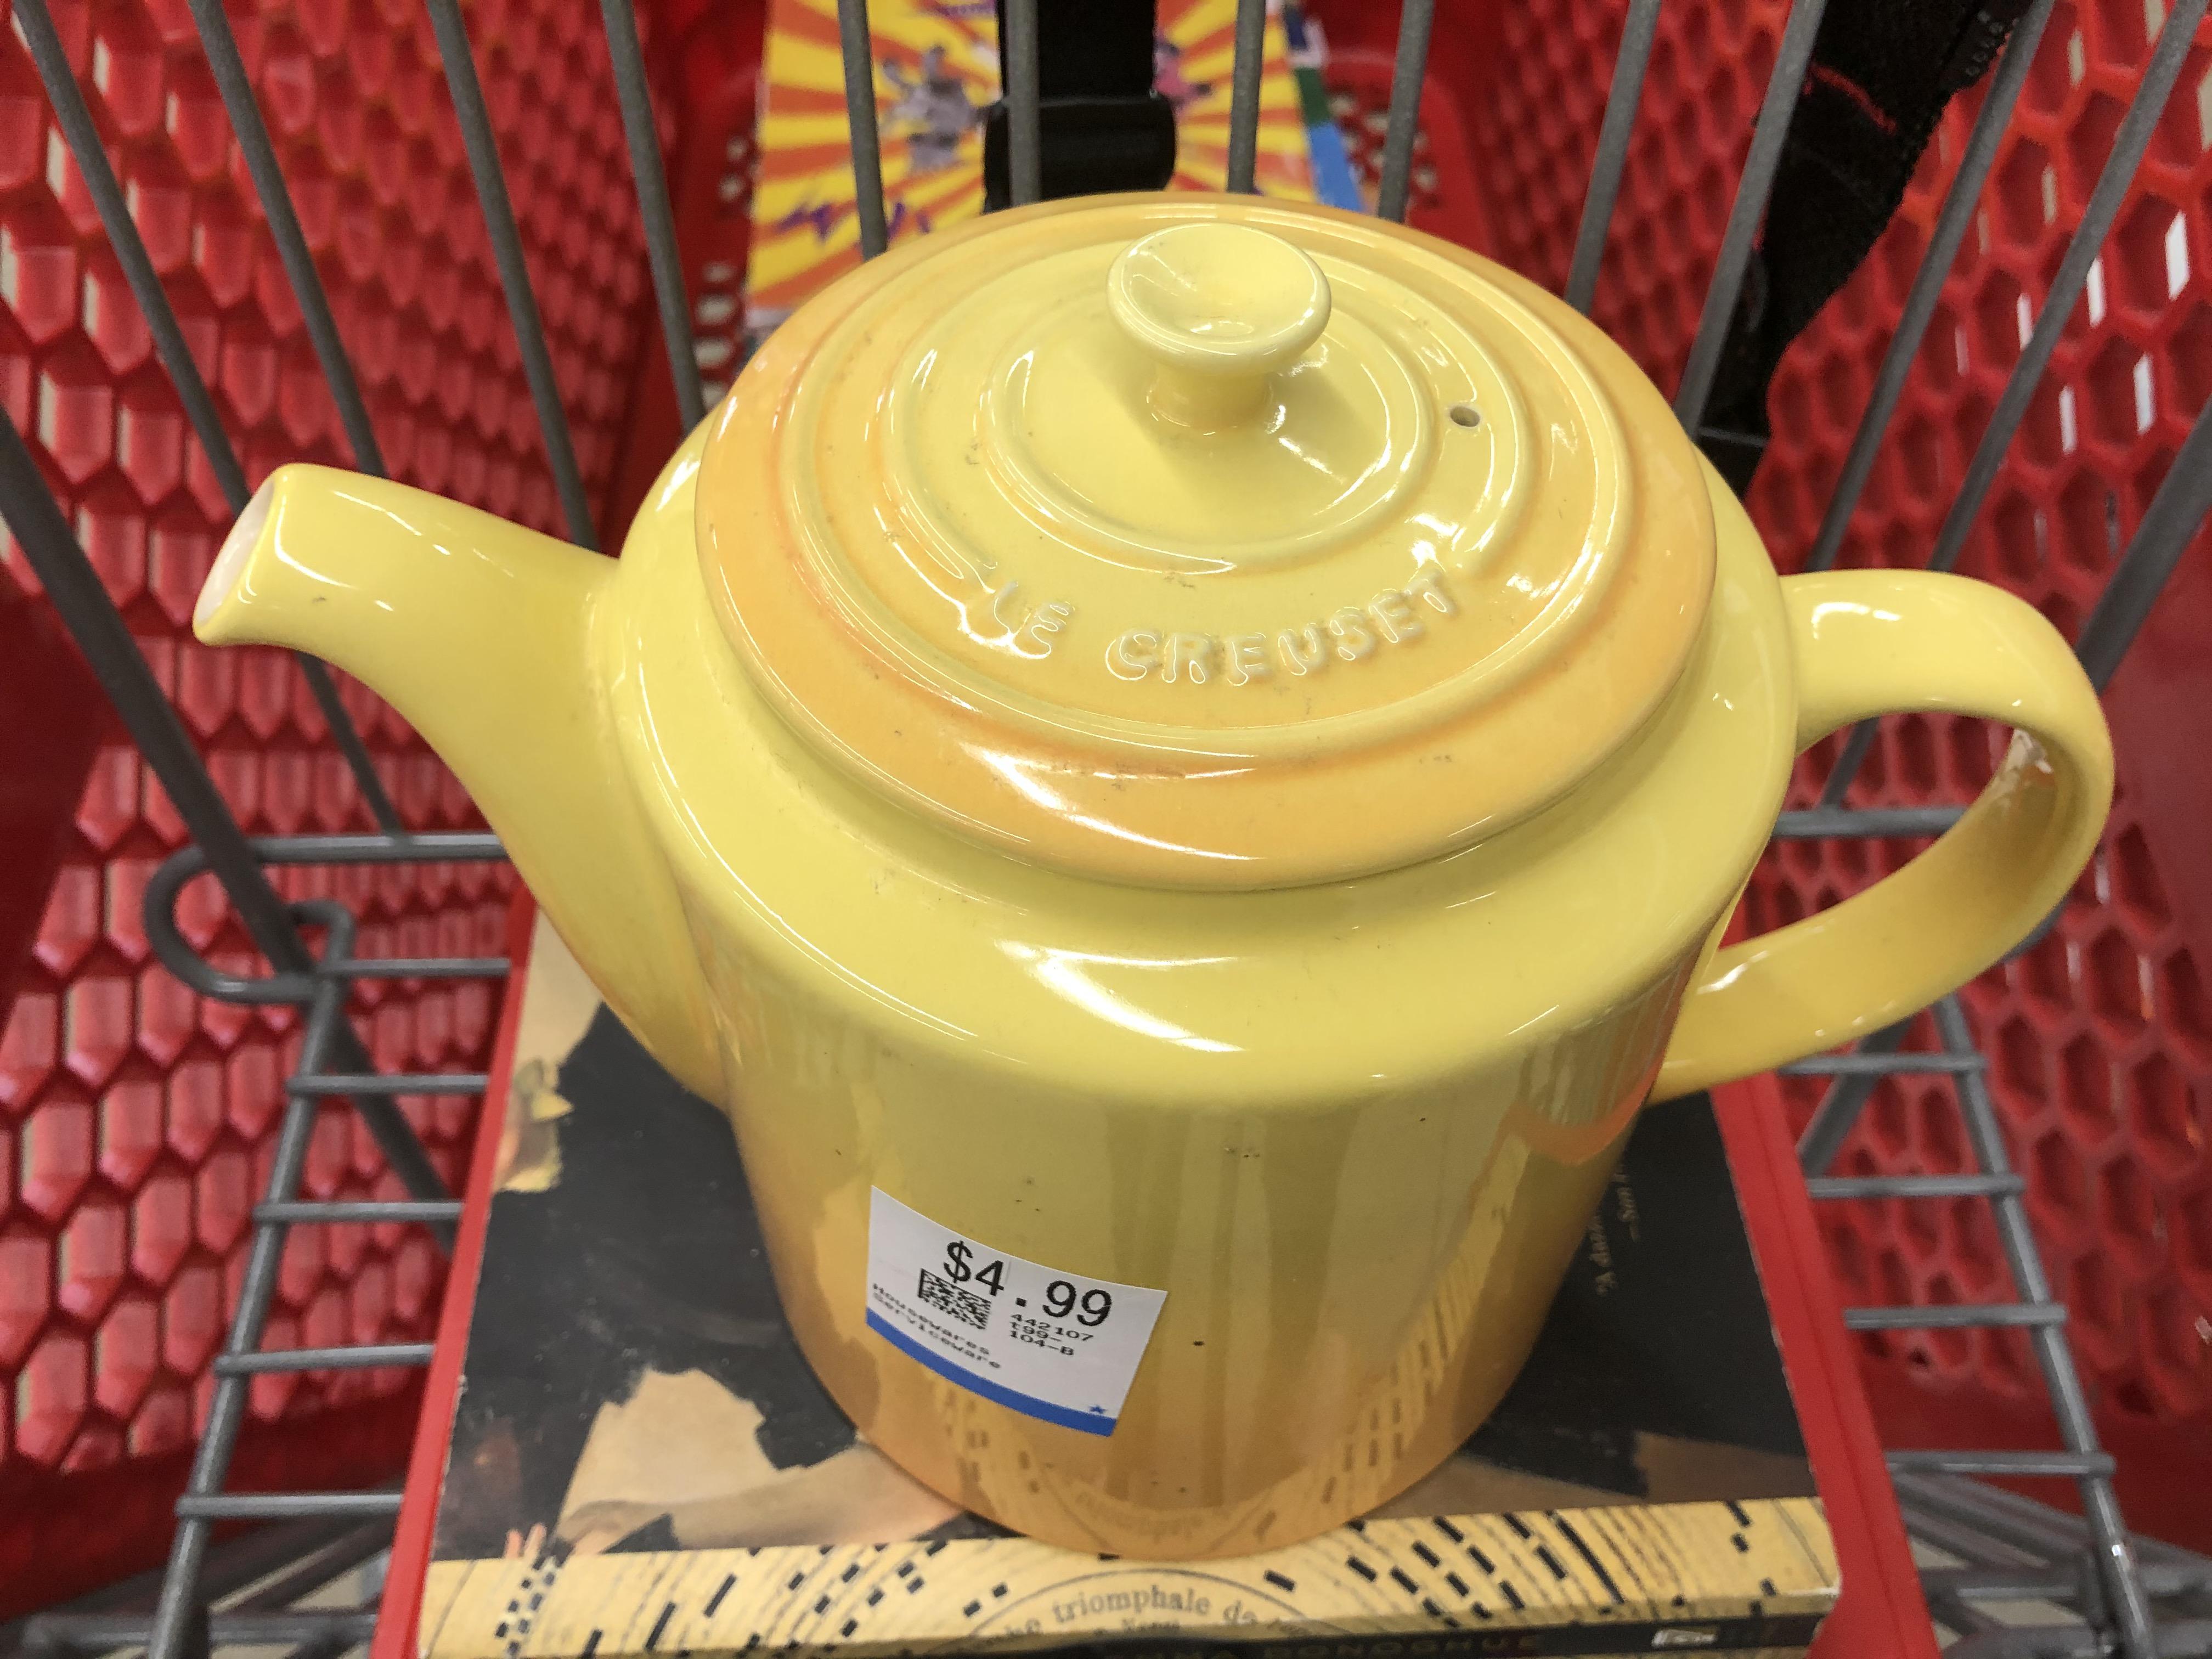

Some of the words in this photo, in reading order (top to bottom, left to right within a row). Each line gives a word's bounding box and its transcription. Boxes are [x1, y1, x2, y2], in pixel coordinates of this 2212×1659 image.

[991, 579, 1075, 658] LE
[1104, 572, 1458, 686] CREUSET
[873, 1283, 990, 1355] Housewares
[943, 1240, 1113, 1327] $4.99
[873, 1292, 1001, 1368] Serviceware
[1010, 1314, 1094, 1341] 442107
[1010, 1330, 1075, 1356] 104-B
[1052, 1583, 1211, 1623] triomphale
